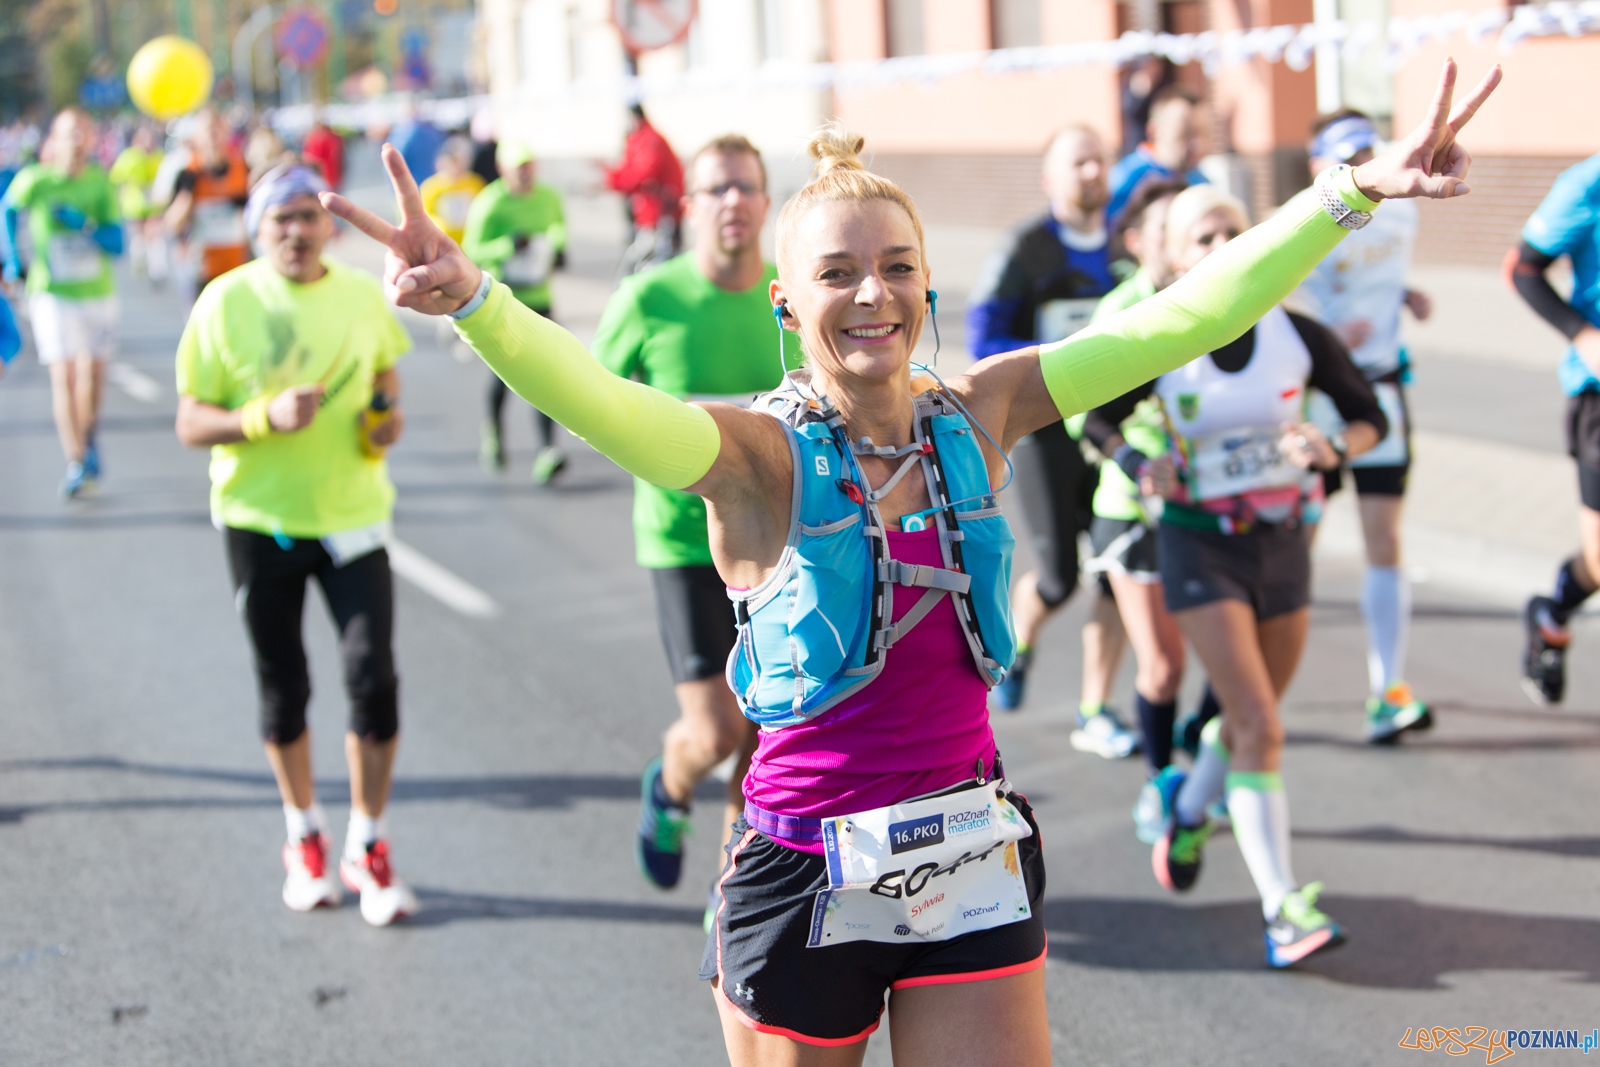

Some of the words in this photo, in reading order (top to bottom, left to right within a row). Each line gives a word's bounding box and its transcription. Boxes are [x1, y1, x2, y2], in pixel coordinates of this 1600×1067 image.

[894, 830, 912, 845] 16.
[913, 823, 939, 841] PKO
[948, 818, 990, 835] maraton
[911, 893, 945, 918] Sylwia
[931, 921, 945, 934] Polski
